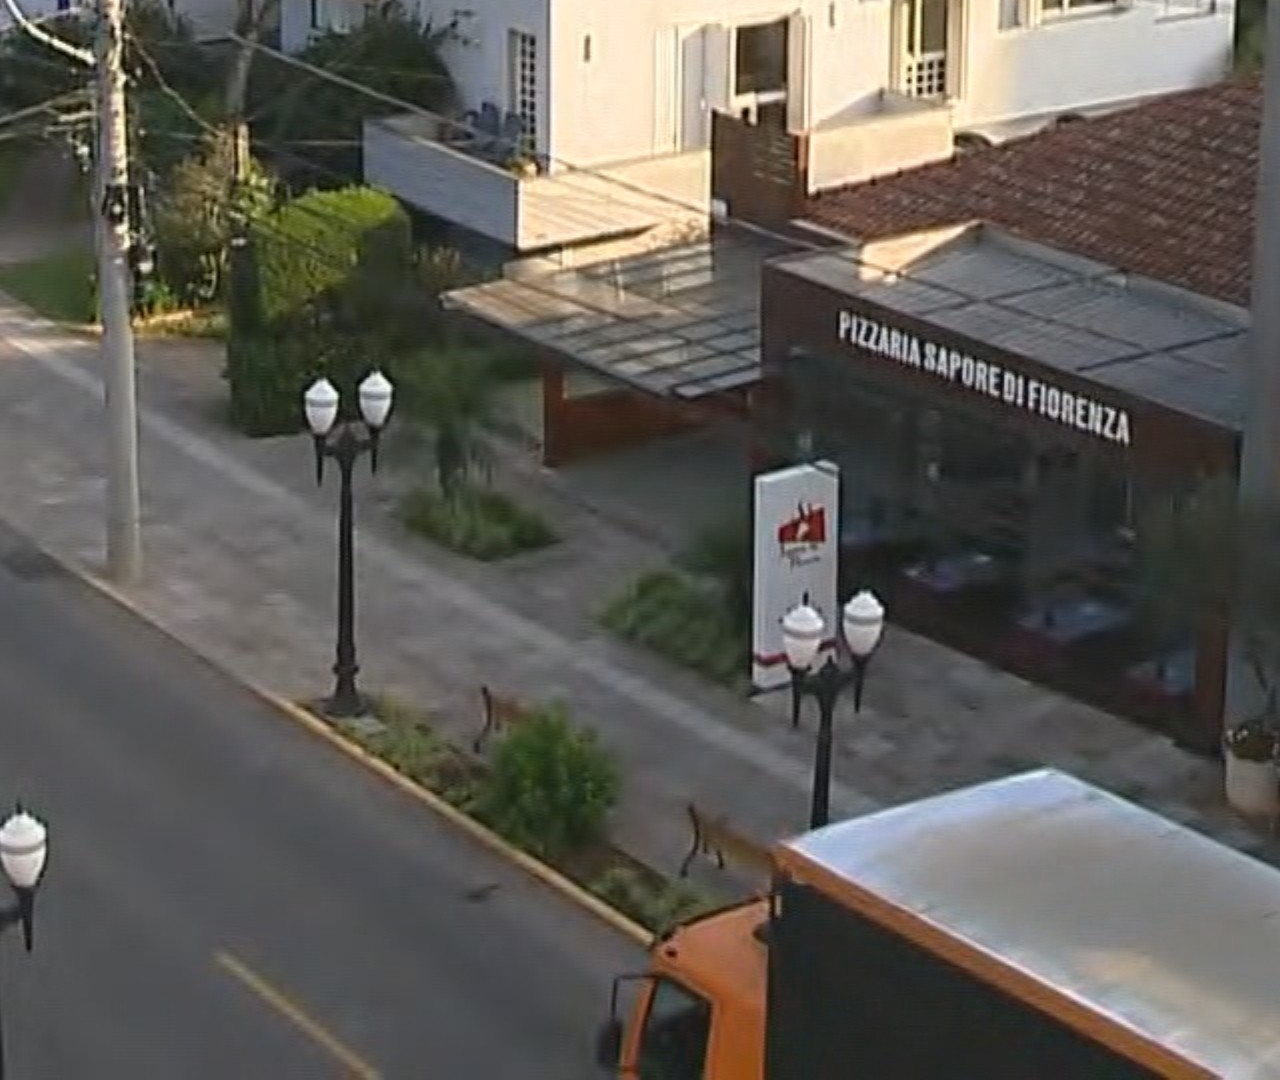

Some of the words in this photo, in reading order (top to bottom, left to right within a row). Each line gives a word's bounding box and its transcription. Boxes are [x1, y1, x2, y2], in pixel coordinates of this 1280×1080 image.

[838, 311, 921, 367] PIZZARIA
[923, 342, 1001, 397] SAPORE
[1003, 371, 1024, 405] DI
[1027, 380, 1130, 445] FIORENZA
